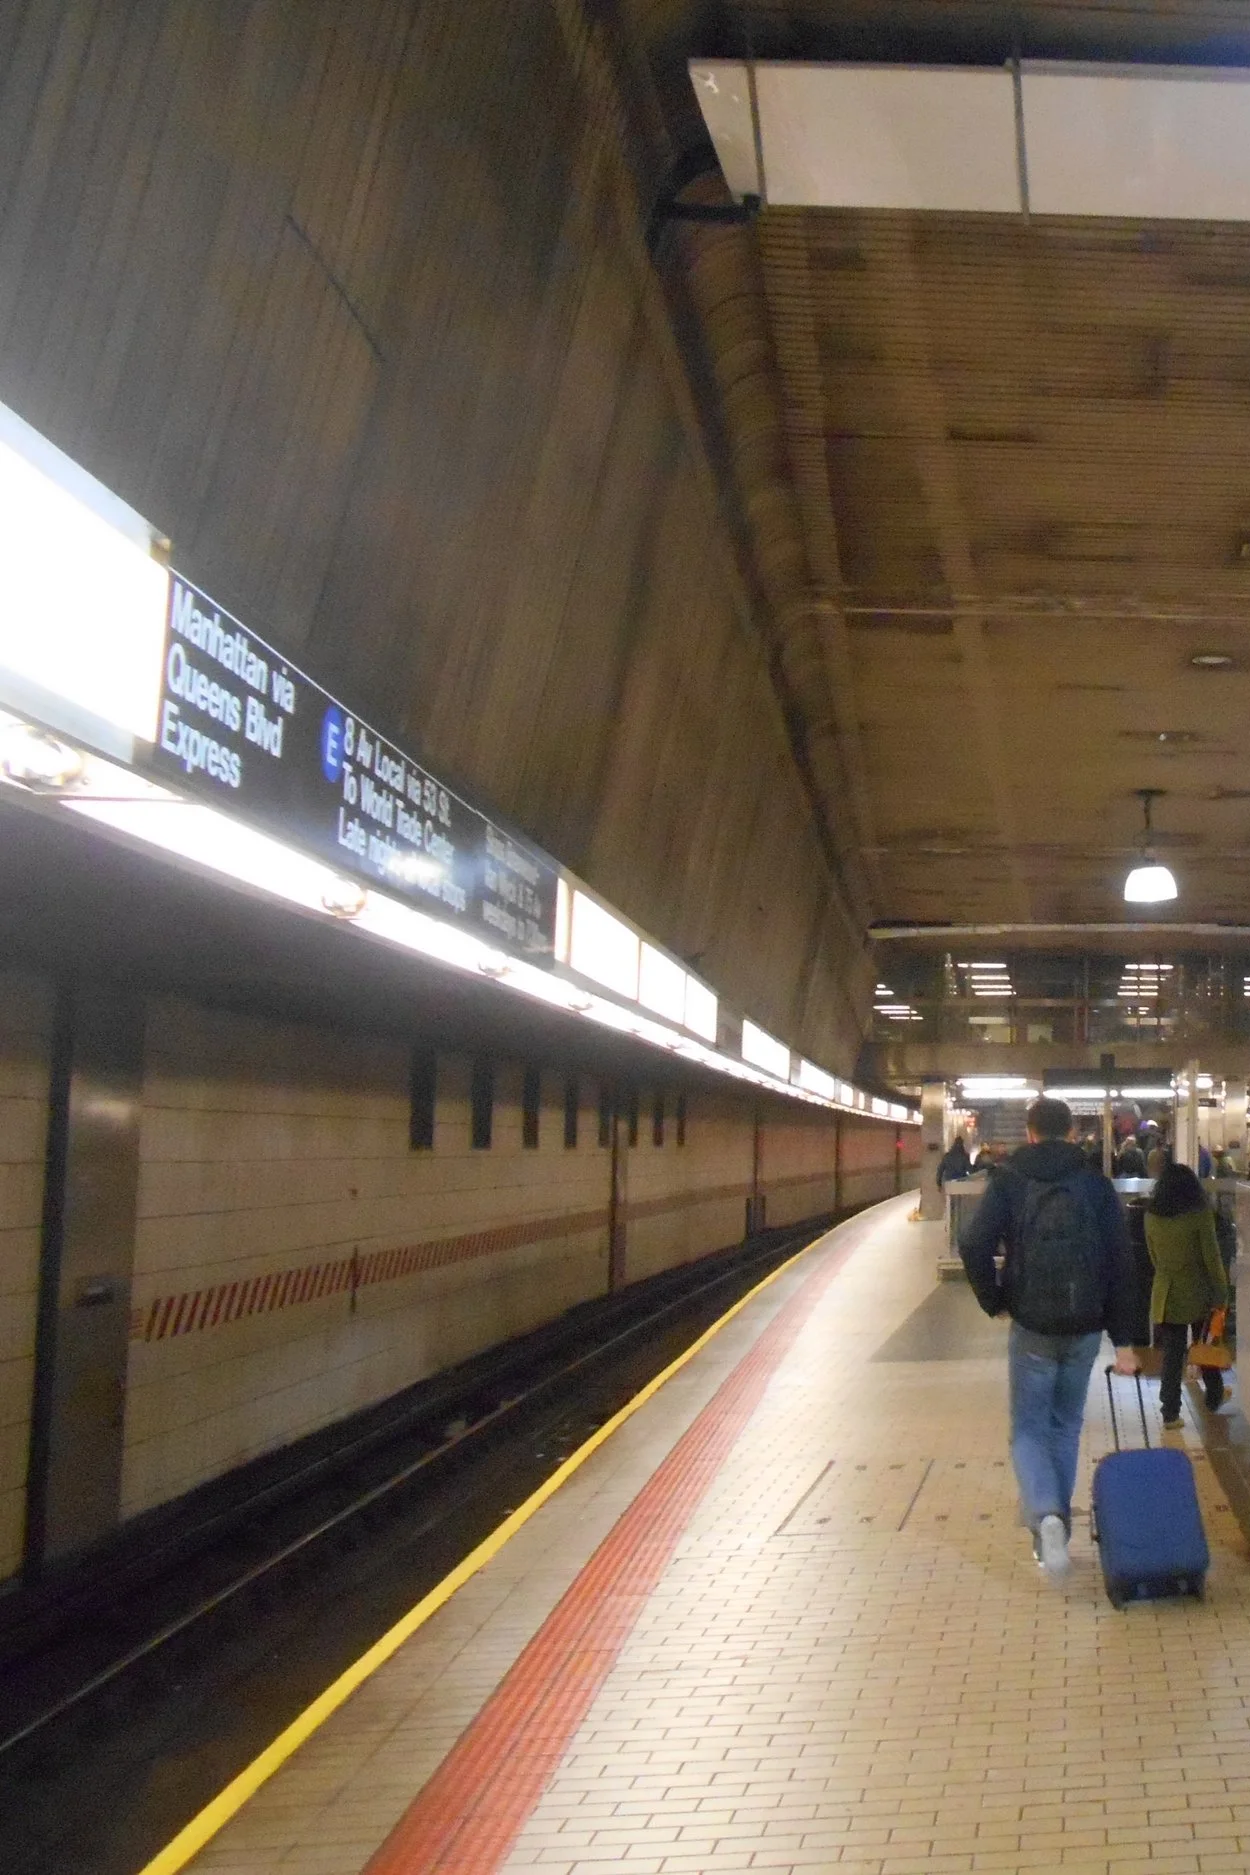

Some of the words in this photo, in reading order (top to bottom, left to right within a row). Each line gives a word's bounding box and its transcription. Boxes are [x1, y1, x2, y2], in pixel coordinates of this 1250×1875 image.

[171, 580, 268, 694] Manhattan
[272, 666, 294, 714] via
[161, 699, 241, 788] Express
[167, 642, 241, 732] Queens
[245, 695, 283, 758] Blvd
[342, 760, 357, 805] To
[361, 773, 393, 828] World
[395, 797, 422, 847] Trade
[425, 819, 455, 866] Center
[343, 716, 354, 756] 8
[356, 728, 373, 769] Av
[374, 739, 405, 794] Local
[407, 768, 421, 806] via
[423, 778, 437, 816] 53
[338, 806, 366, 857] Late
